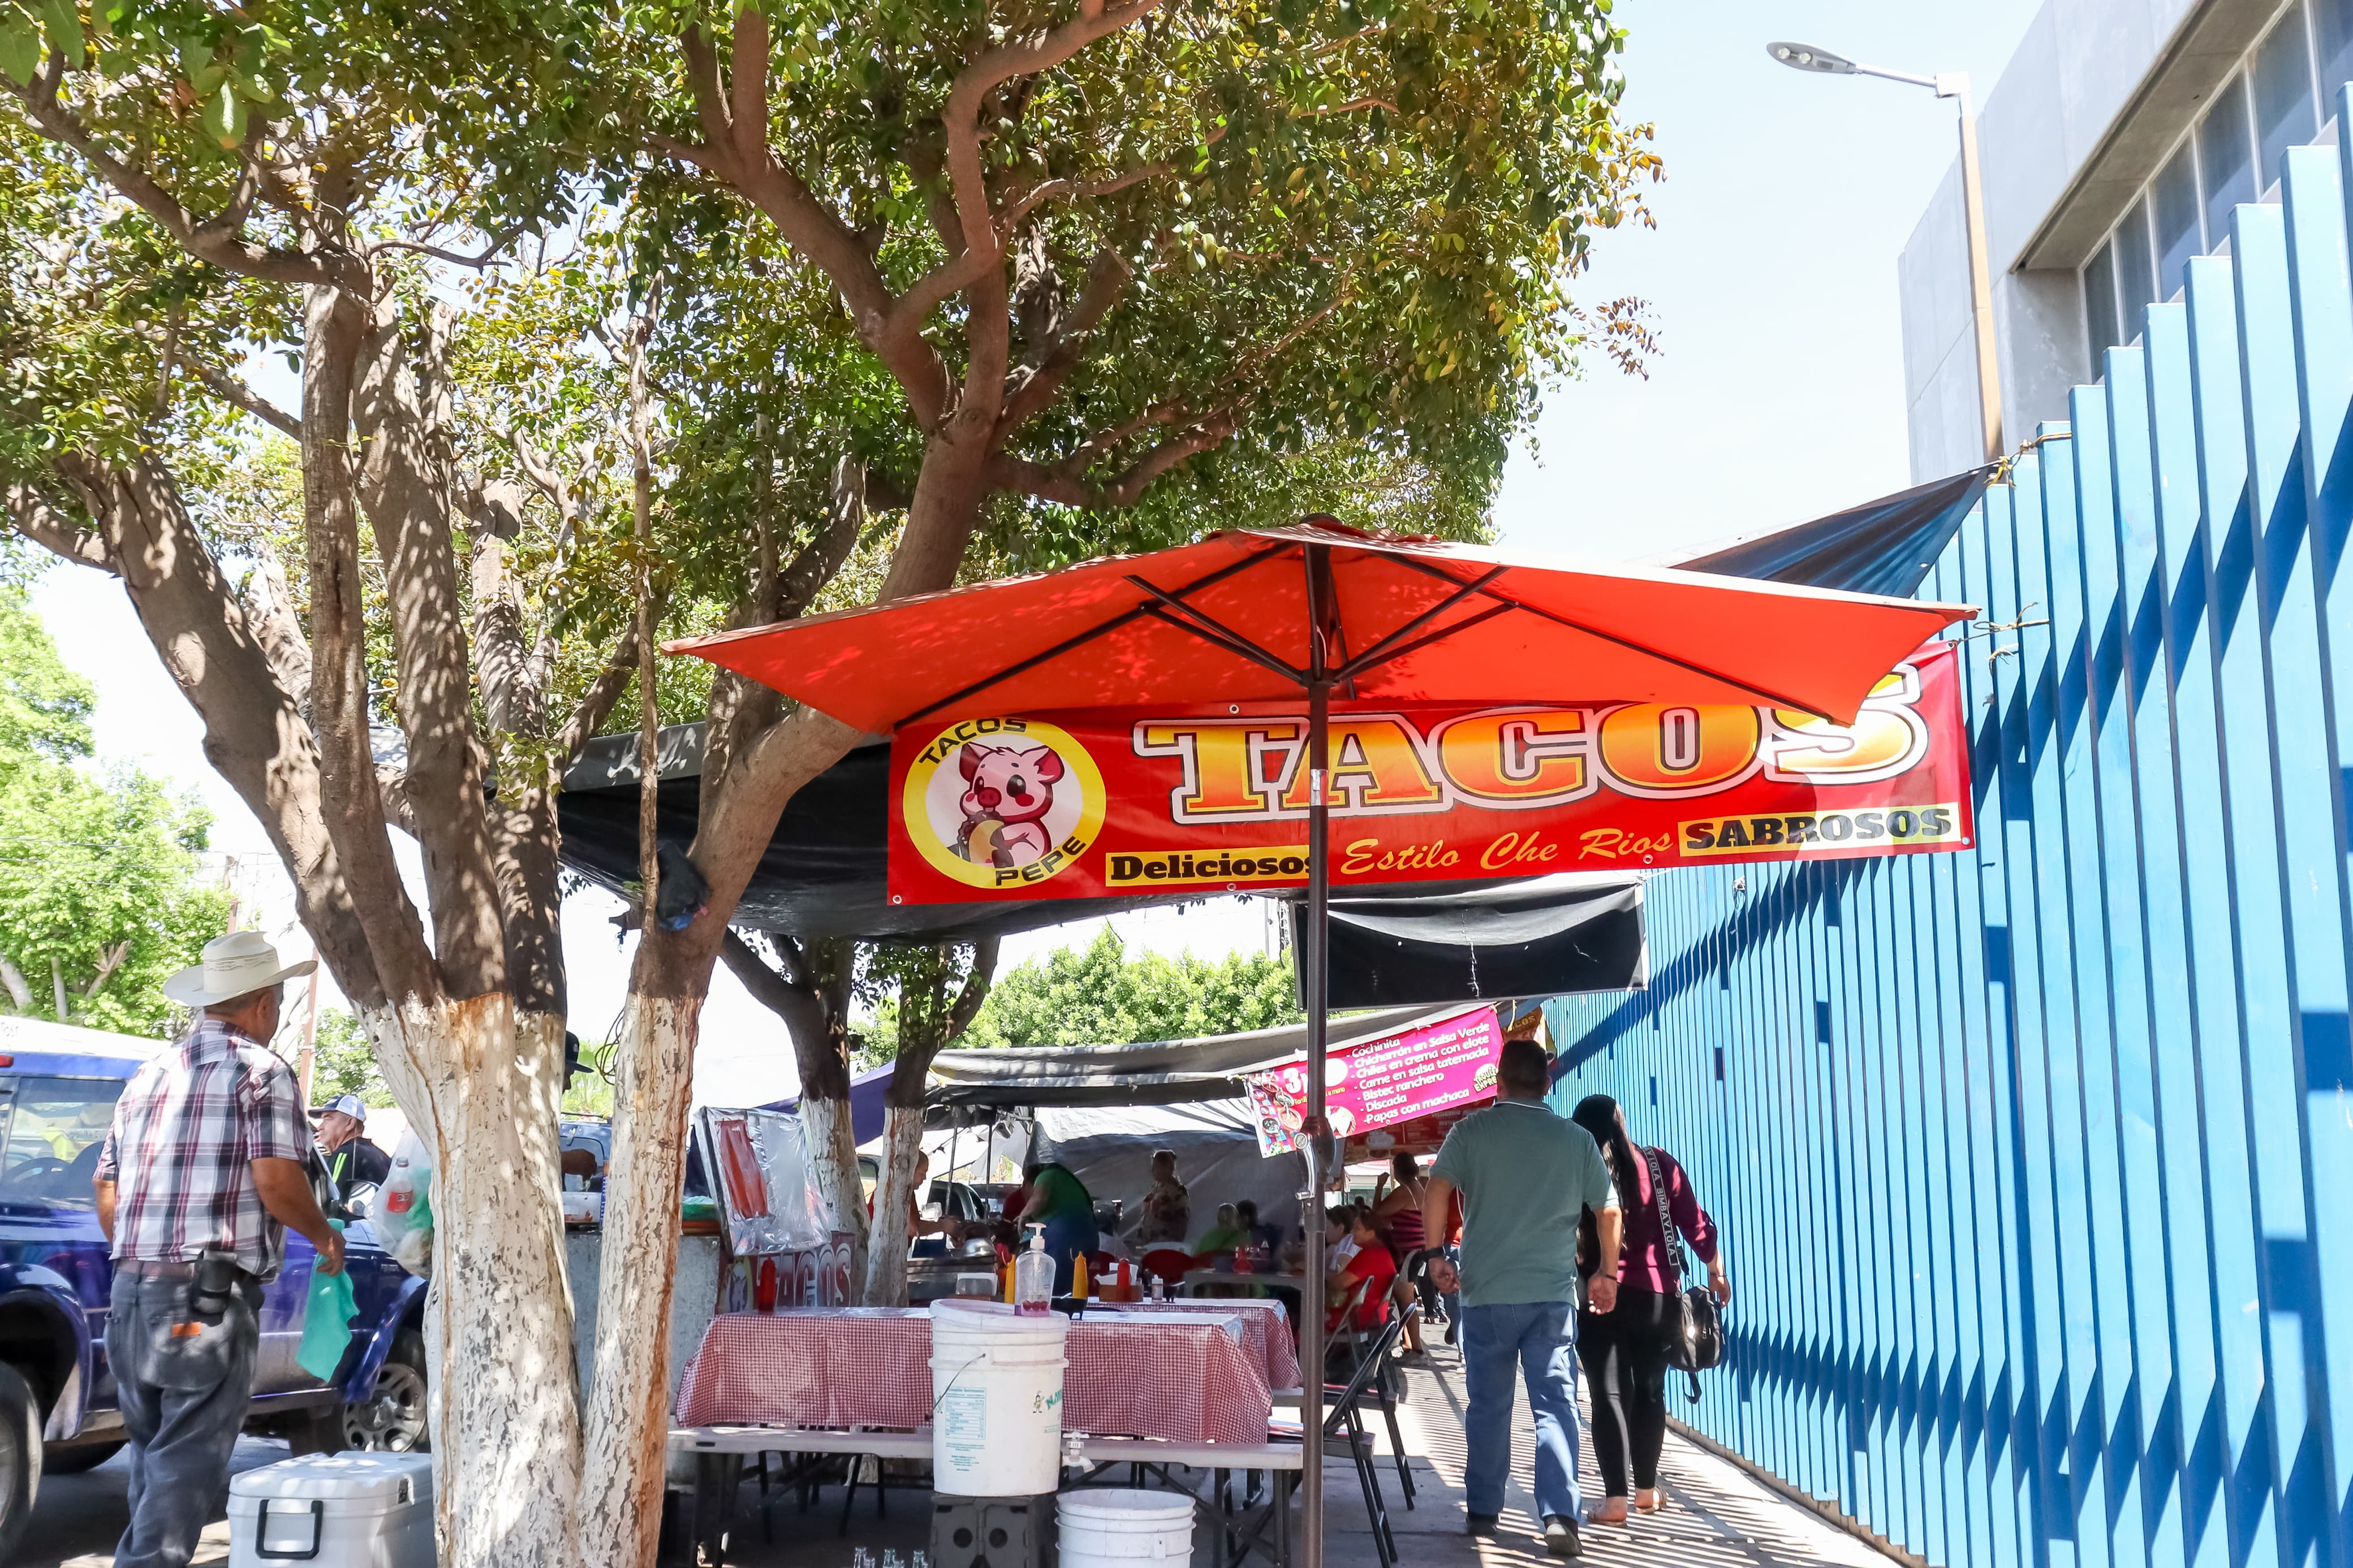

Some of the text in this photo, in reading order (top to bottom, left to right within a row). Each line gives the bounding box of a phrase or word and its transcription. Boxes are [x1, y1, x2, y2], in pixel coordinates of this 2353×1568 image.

[918, 718, 1027, 765] TACOS
[1133, 663, 1930, 826] TACOS
[1685, 809, 1953, 850] SABROSOS
[995, 836, 1087, 886] PEPE
[1340, 828, 1674, 875] Estilo Che Rios
[1351, 1038, 1400, 1058] Cochinita
[1413, 1042, 1428, 1052] en
[1429, 1031, 1457, 1048] Salsa
[1457, 1022, 1490, 1038] Verde
[1356, 1035, 1489, 1079] Chiles en crema con elote
[1392, 1071, 1407, 1082] en
[1408, 1061, 1435, 1078] salsa
[1283, 1066, 1302, 1094] 3
[1362, 1072, 1445, 1102] Bistec ranchero
[1365, 1093, 1408, 1112] Discada
[1400, 1103, 1421, 1115] con
[1421, 1087, 1471, 1109] machaca
